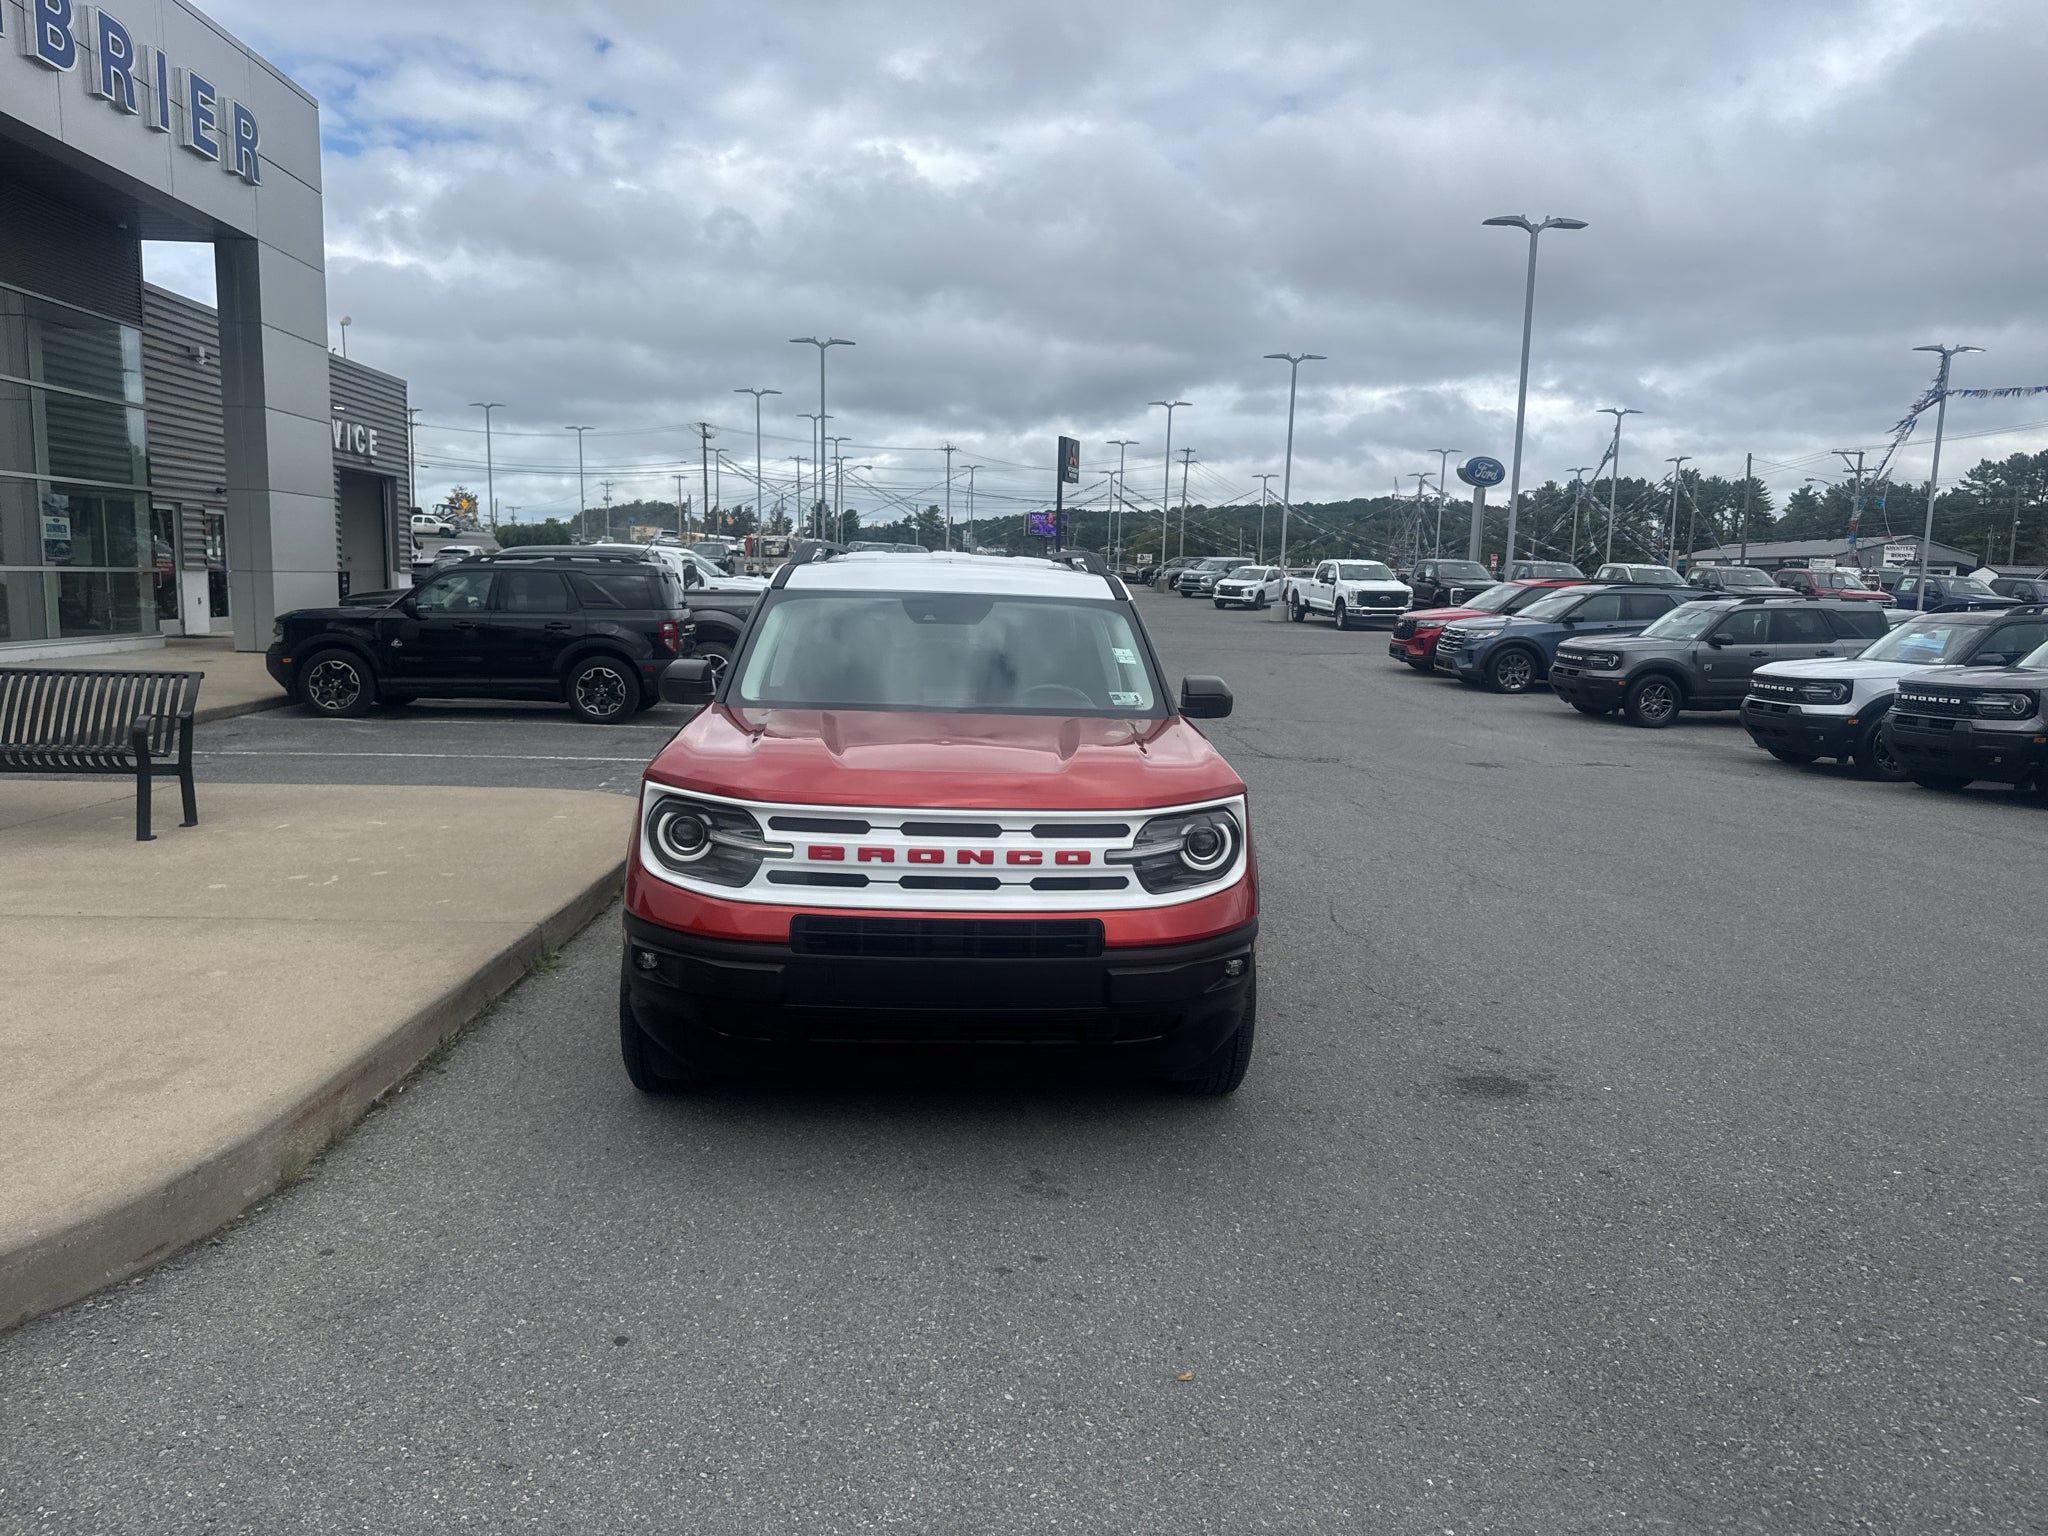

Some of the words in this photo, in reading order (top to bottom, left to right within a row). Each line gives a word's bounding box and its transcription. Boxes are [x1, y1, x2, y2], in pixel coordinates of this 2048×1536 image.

[0, 0, 263, 187] BRIER
[331, 418, 378, 457] VICE
[1474, 461, 1500, 481] Ford
[1031, 513, 1047, 521] NOW
[1752, 682, 1794, 692] BRONCO
[1900, 693, 1961, 704] BRONCO
[807, 844, 1092, 865] BRONCO
